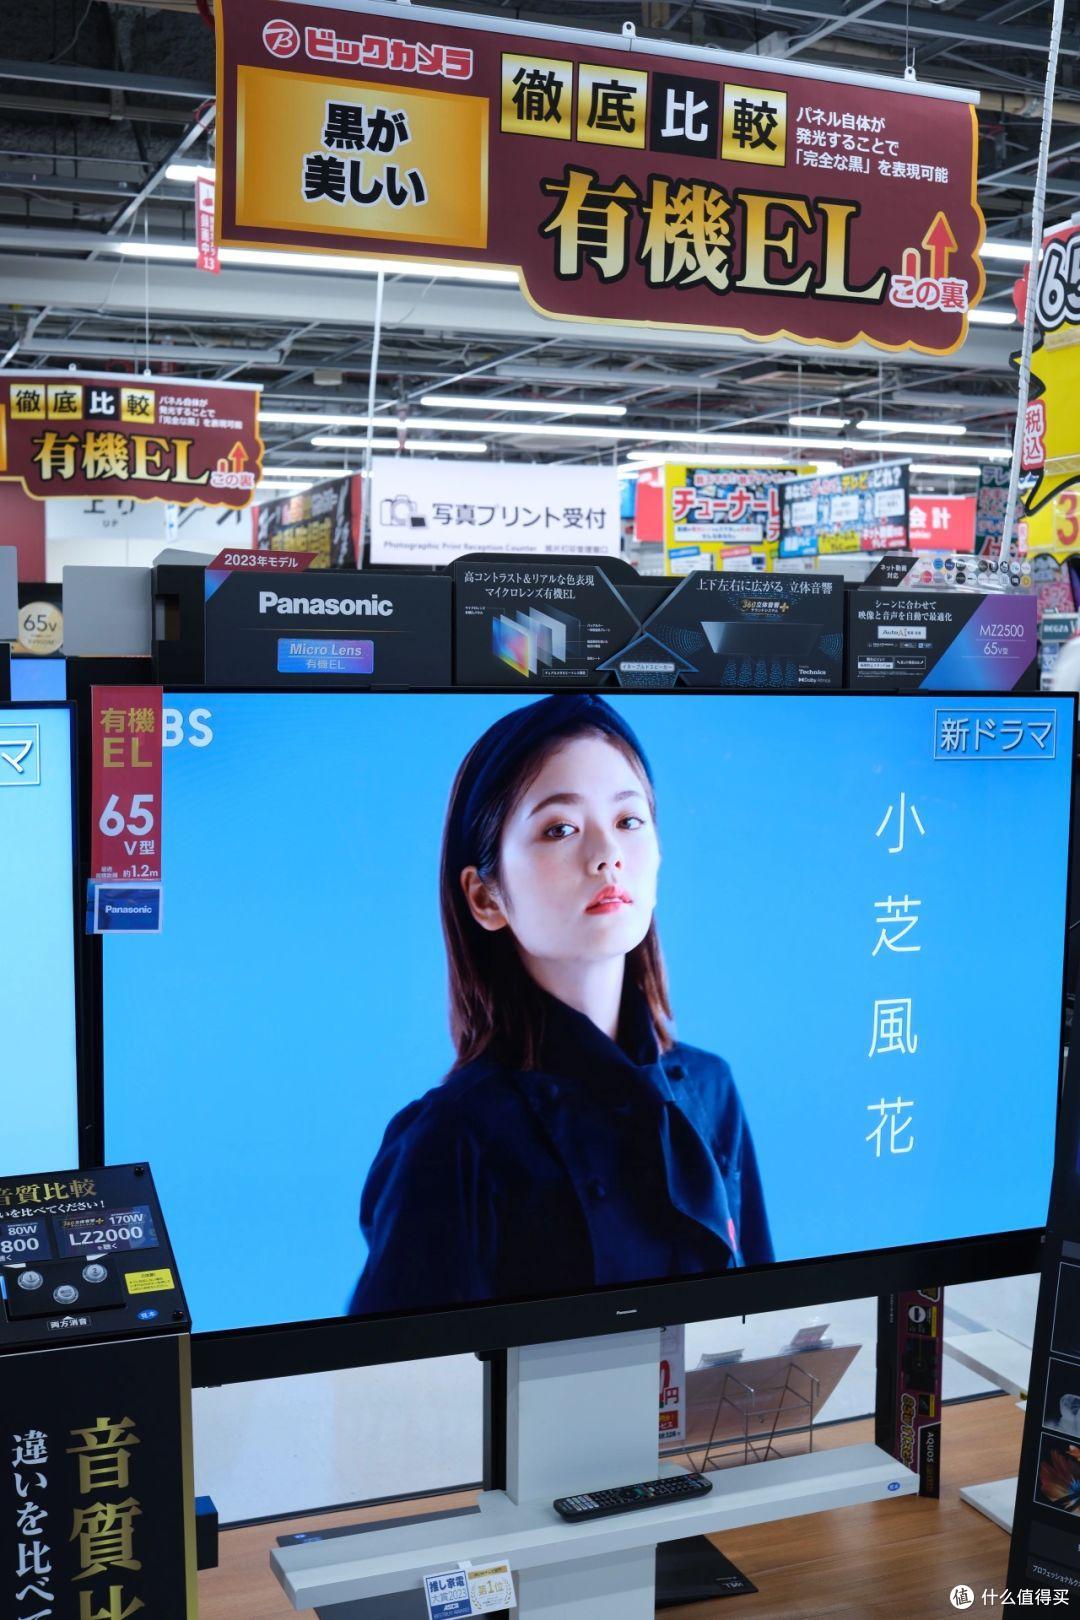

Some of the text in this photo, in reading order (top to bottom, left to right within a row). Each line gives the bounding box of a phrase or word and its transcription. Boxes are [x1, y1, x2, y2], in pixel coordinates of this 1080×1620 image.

[304, 27, 473, 80] ビックカメラ
[512, 67, 778, 151] 徹底比較
[795, 106, 886, 132] パネル自体が
[324, 102, 410, 152] 黒が
[795, 128, 899, 156] 発光することで
[304, 154, 427, 206] 美しい
[795, 150, 949, 184] 「完全な黒」を表現可能
[541, 166, 887, 303] 有機EL
[890, 276, 969, 312] この裏
[16, 388, 151, 417] 徹底比較
[1025, 408, 1041, 460] 税込
[33, 429, 211, 485] 有機EL
[432, 503, 607, 529] 写真プリント受付
[224, 553, 299, 569] 2023年モデル
[485, 588, 576, 600] マイクロレンズ有機EL
[697, 578, 833, 595] 上下左右に広がる 立体音響
[259, 590, 394, 617] Panasonic
[858, 610, 953, 622] 映像と音声を自動で最適化
[875, 600, 937, 610] シーンに合わせて
[980, 624, 1024, 638] MZ2500
[290, 643, 363, 656] Micro Lens
[306, 659, 346, 670] 有機EL
[100, 707, 156, 735] 有機
[940, 717, 1053, 752] 新ドラマ
[102, 737, 153, 768] EL
[98, 794, 154, 837] 65
[124, 839, 156, 856] V型
[123, 864, 159, 878] 約1.2m
[105, 904, 152, 914] Panasonic
[865, 791, 926, 1159] 小芝風花
[8, 1225, 37, 1236] 80W
[108, 1213, 144, 1226] 170W
[69, 1226, 144, 1247] LZ2000
[926, 1432, 934, 1464] AQUOS
